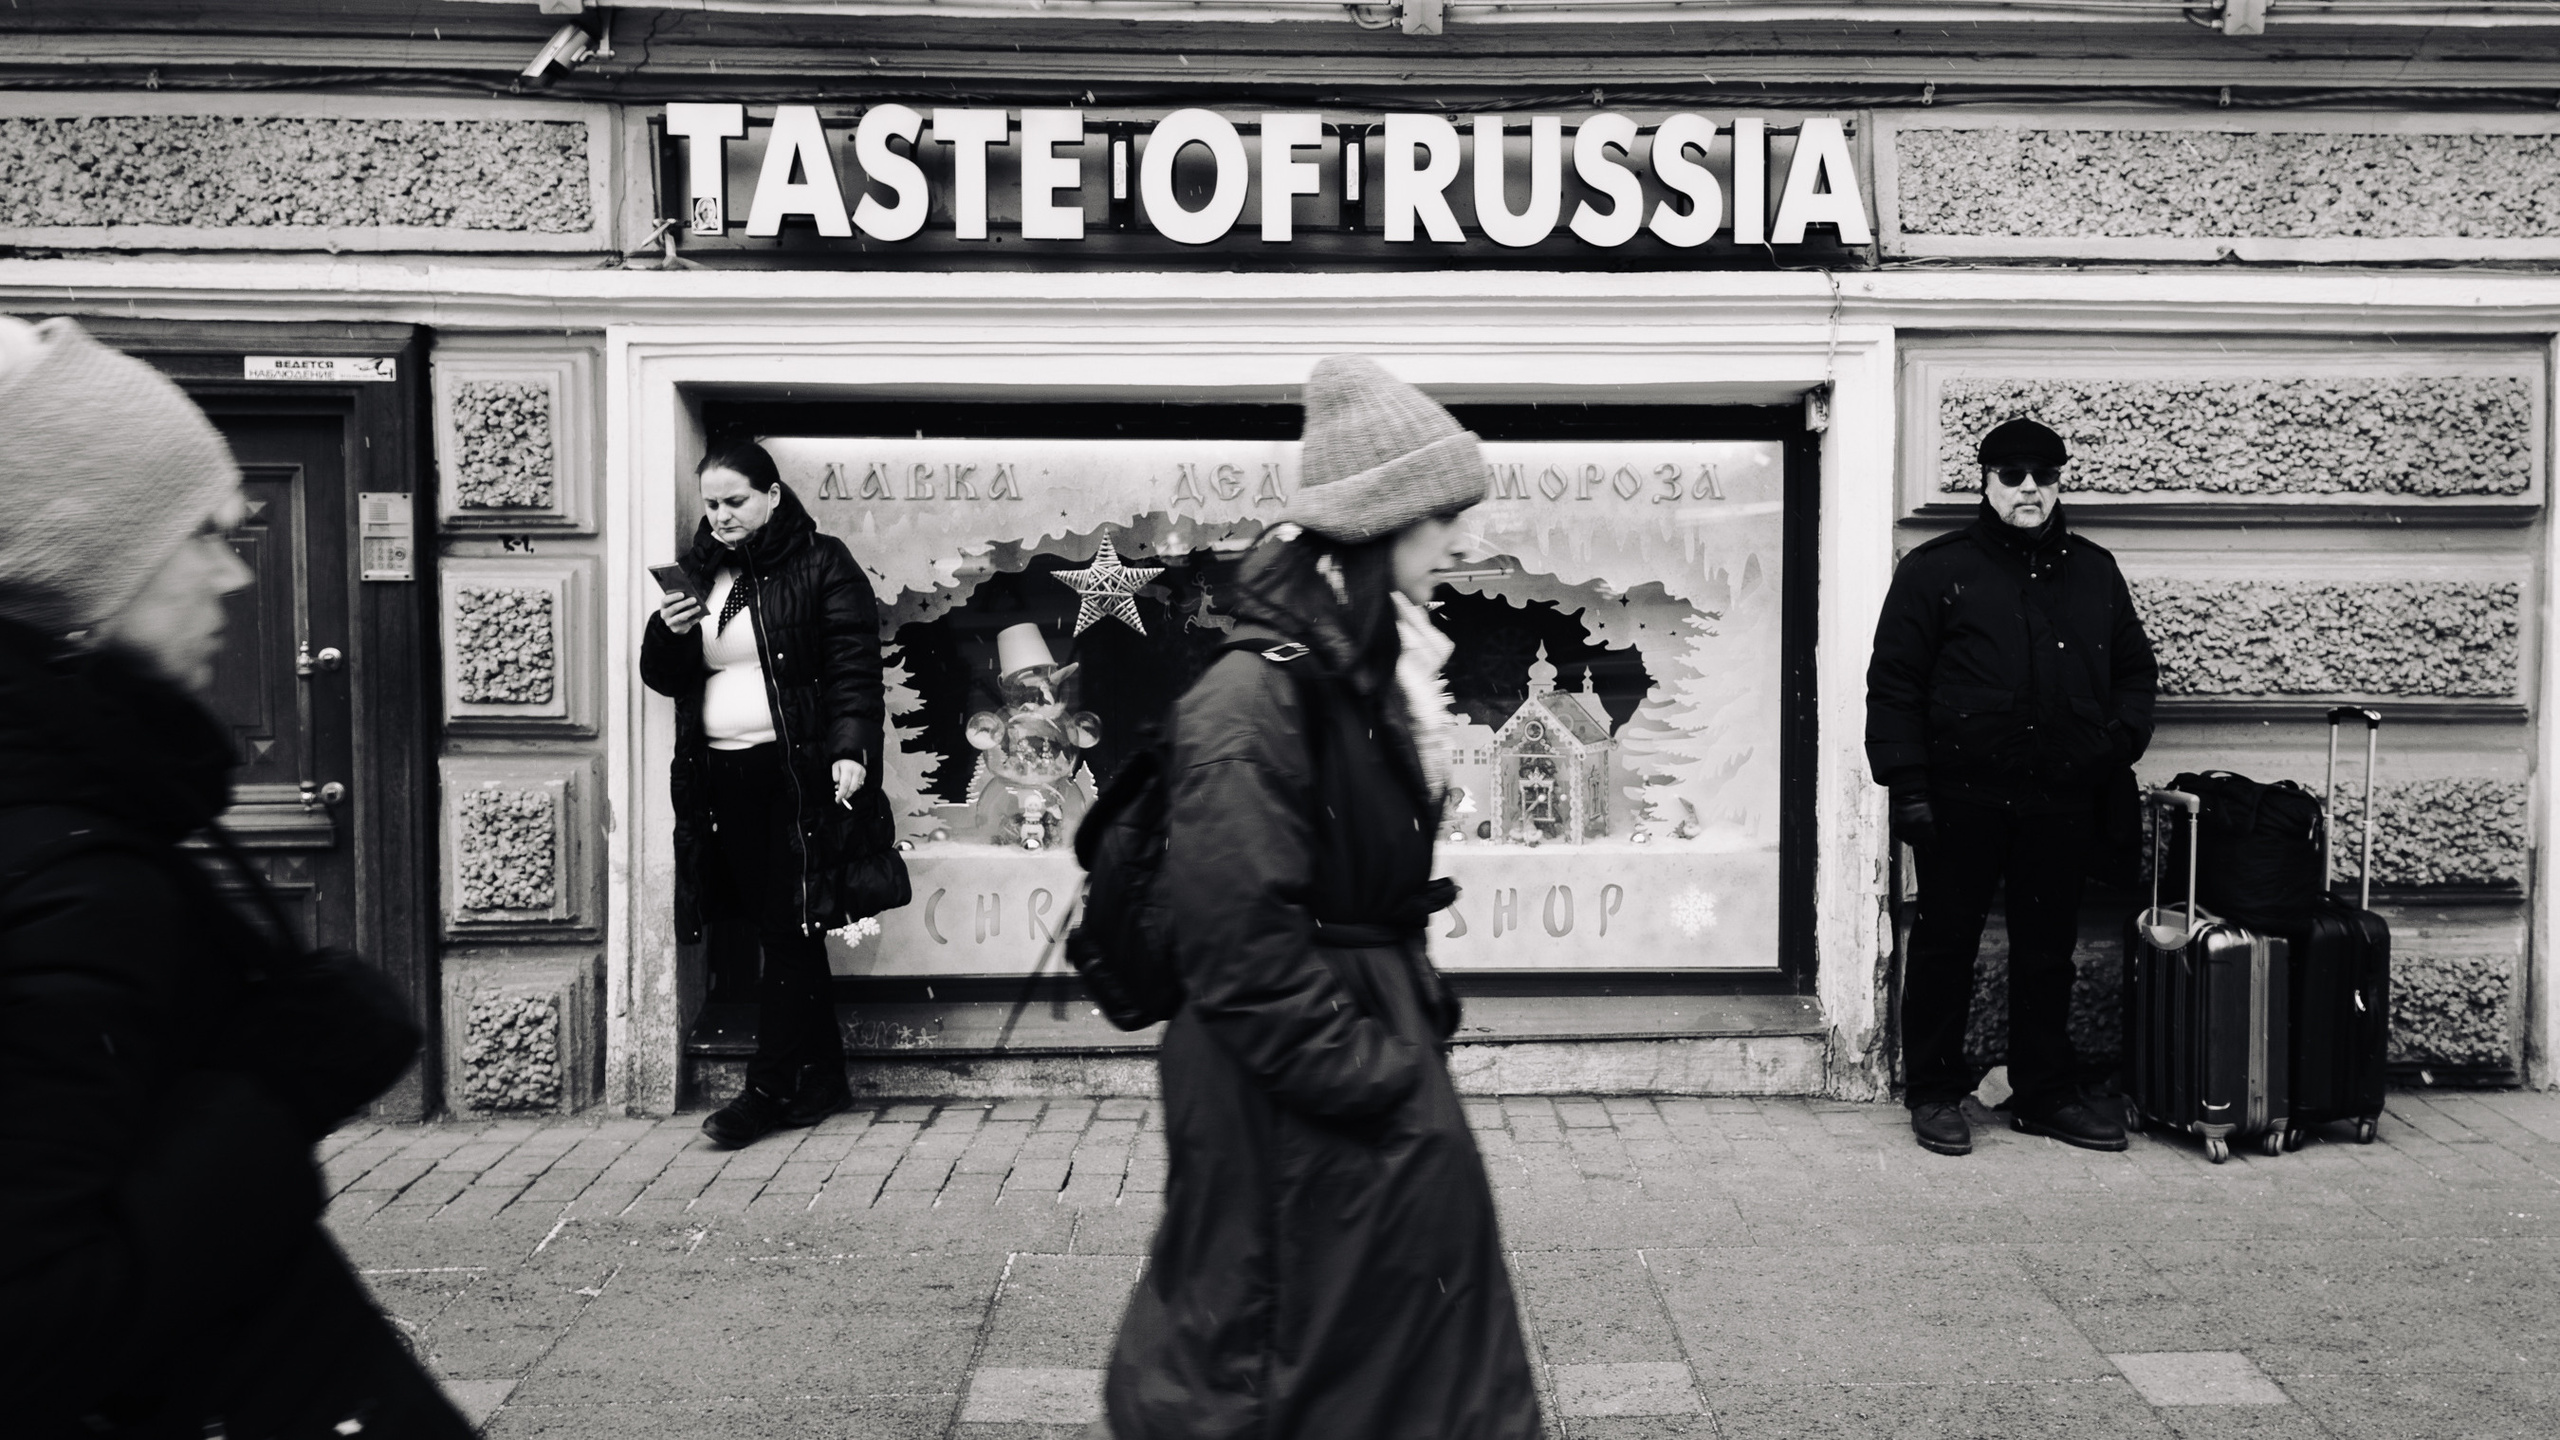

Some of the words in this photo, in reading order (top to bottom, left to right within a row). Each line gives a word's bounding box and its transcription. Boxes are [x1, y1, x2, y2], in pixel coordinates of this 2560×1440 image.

[666, 102, 1084, 242] TASTE
[1140, 107, 1322, 244] OF
[1384, 112, 1873, 247] RUSSIA
[249, 369, 335, 380] НАБЛЮДЕНИЕ
[275, 360, 334, 369] ВЕДЕТСЯ
[818, 462, 1023, 501] ЛАВКА
[1487, 462, 1725, 504] МОРОЗА
